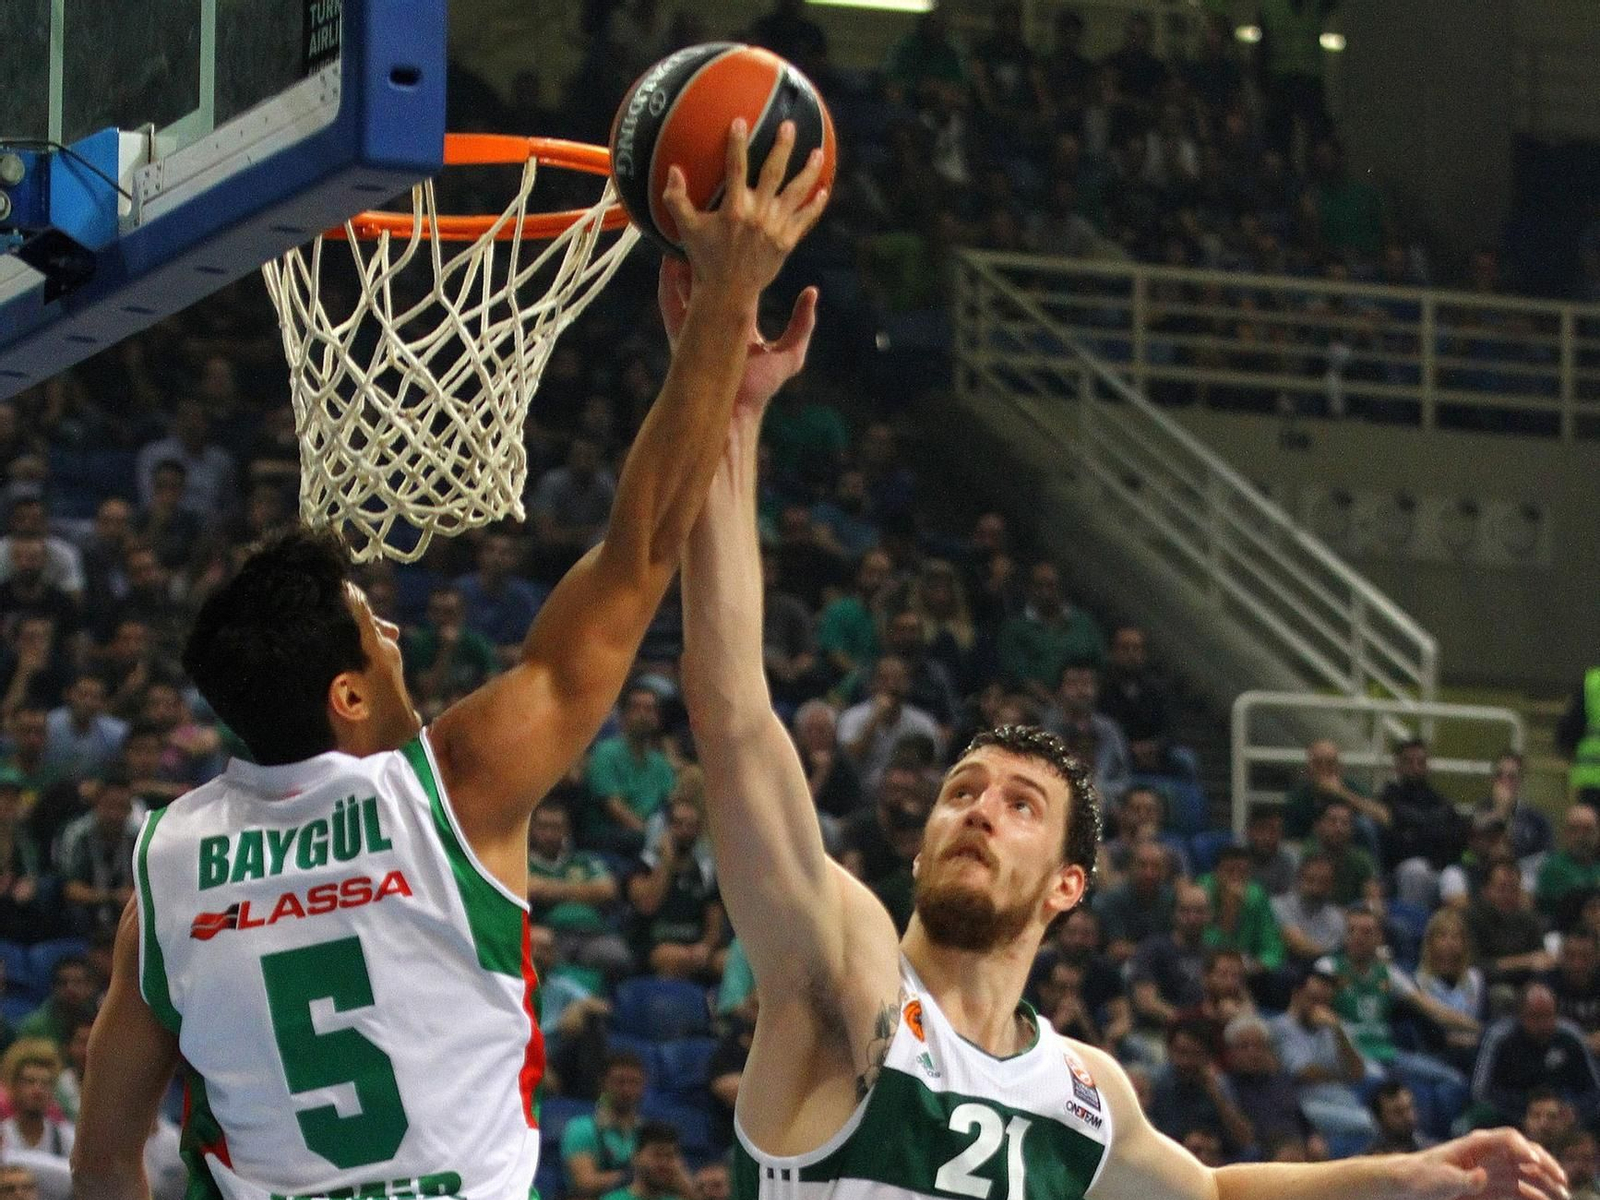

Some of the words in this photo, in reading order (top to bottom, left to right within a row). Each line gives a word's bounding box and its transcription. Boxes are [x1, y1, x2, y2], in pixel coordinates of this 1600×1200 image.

[309, 0, 340, 29] TUR
[198, 795, 393, 892] BAYGÜL
[236, 870, 413, 931] LASSA
[260, 935, 409, 1170] 5
